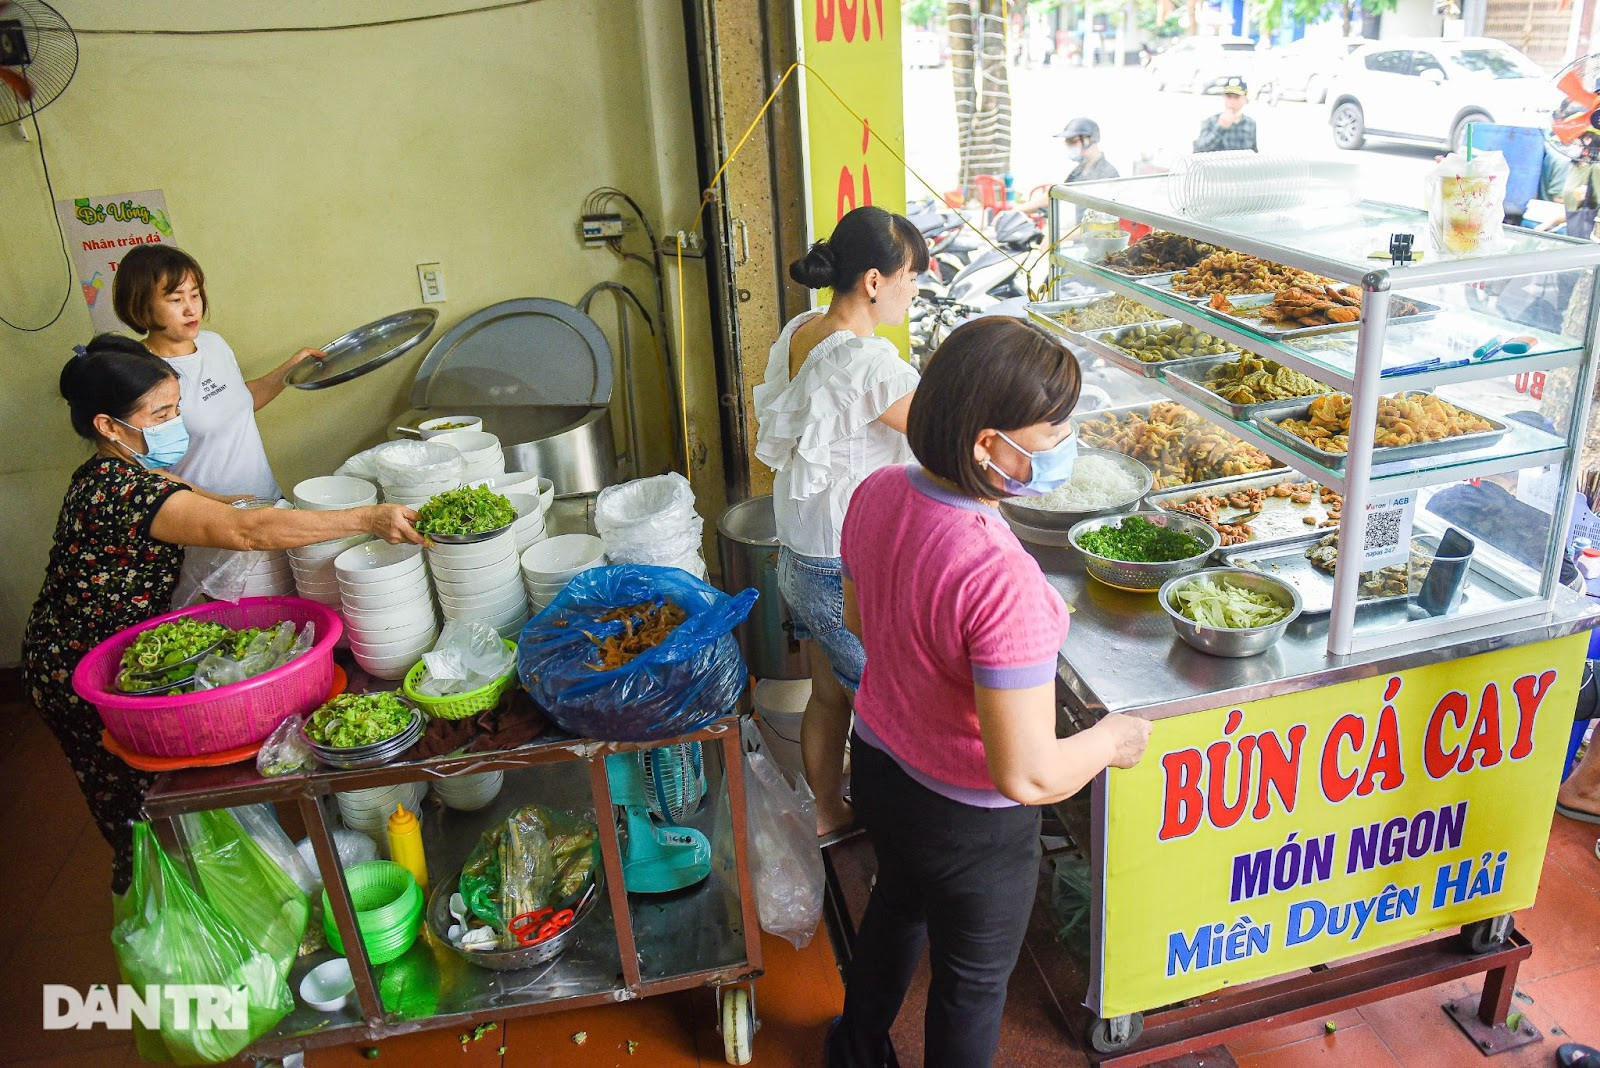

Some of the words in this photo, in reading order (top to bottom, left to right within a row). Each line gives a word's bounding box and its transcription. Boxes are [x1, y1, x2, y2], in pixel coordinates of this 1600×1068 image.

[78, 204, 107, 226] Đồ
[106, 200, 151, 225] Uống
[82, 239, 116, 251] Nhân
[117, 233, 144, 247] trần
[145, 231, 161, 243] đá
[1393, 497, 1410, 507] ACB
[1159, 709, 1307, 841] BÚN
[1320, 676, 1405, 803] CÁ
[1424, 669, 1558, 780] CAY
[1230, 831, 1336, 903] MÓN
[1346, 801, 1469, 875] NGON
